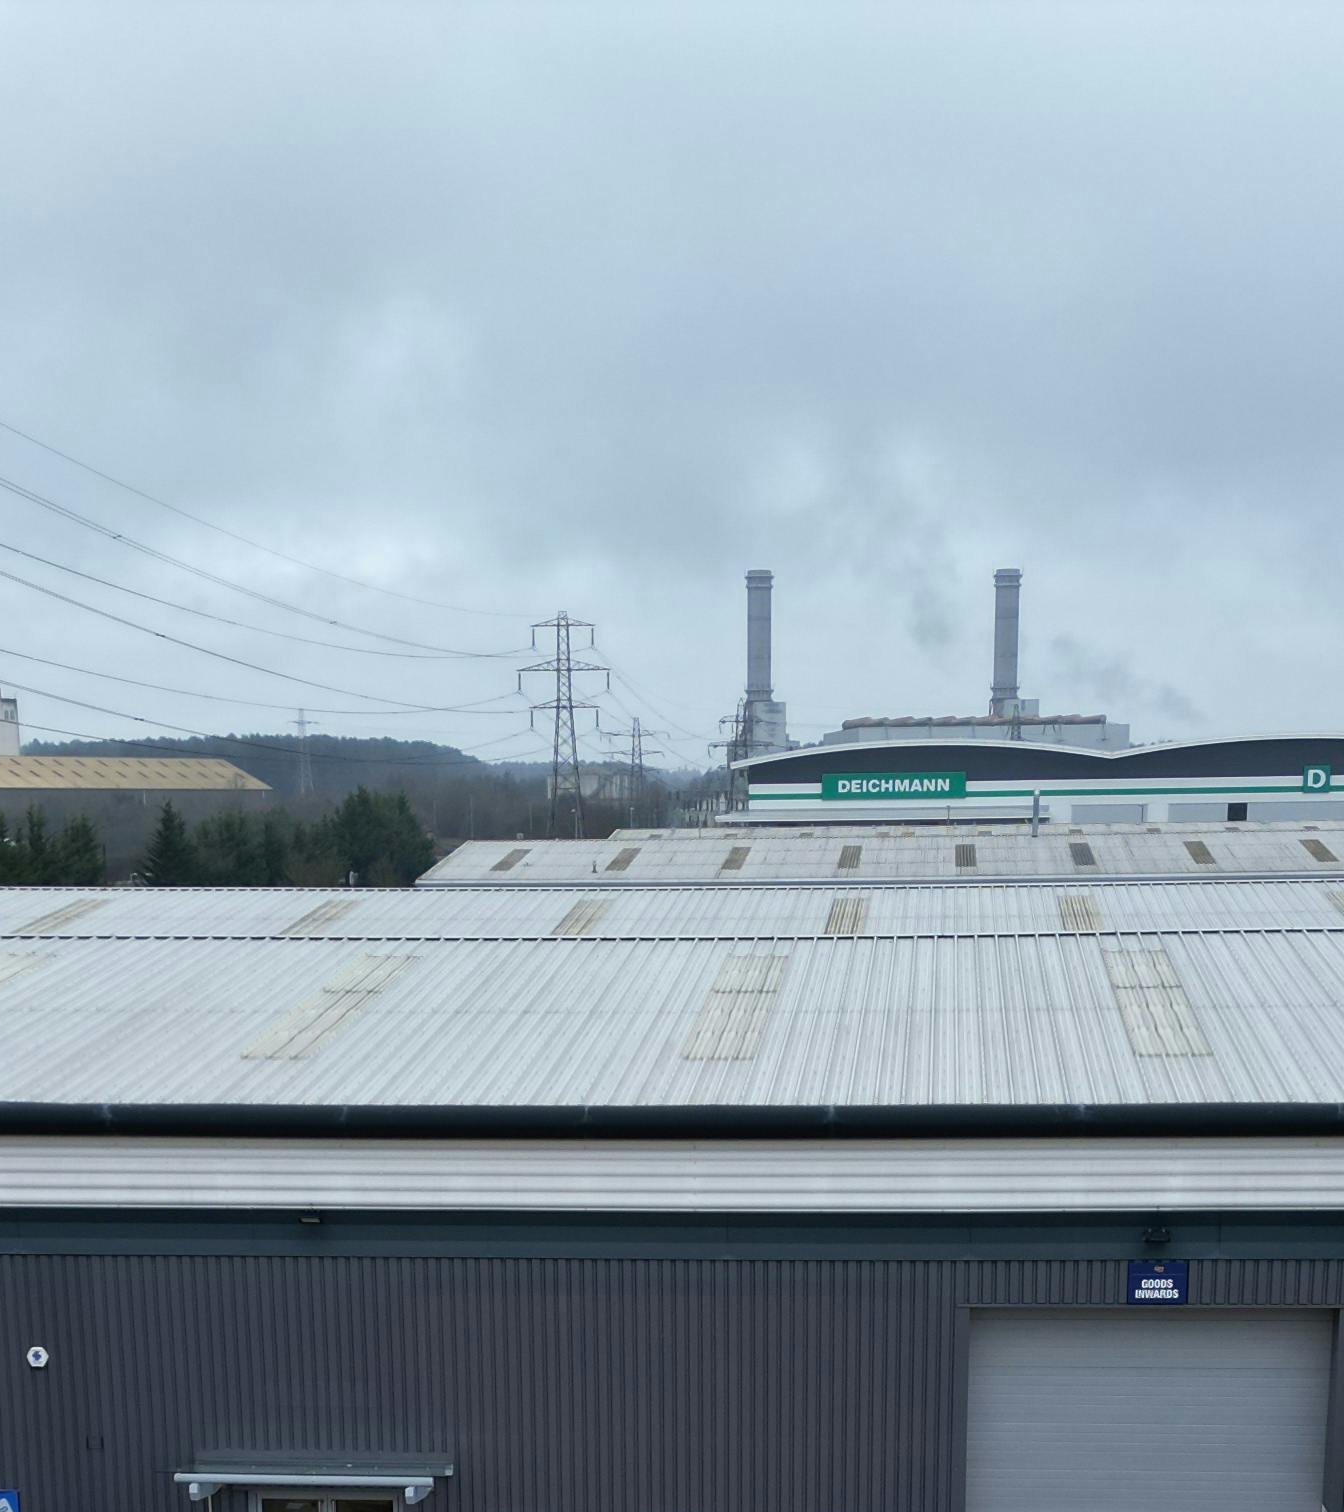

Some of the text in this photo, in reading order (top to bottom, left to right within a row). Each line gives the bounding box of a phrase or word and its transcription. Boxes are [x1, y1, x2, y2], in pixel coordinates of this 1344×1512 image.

[1307, 769, 1326, 788] D
[837, 778, 950, 793] DEICHMANN
[1141, 1279, 1174, 1289] GOODS
[1134, 1289, 1180, 1299] INWARDS
